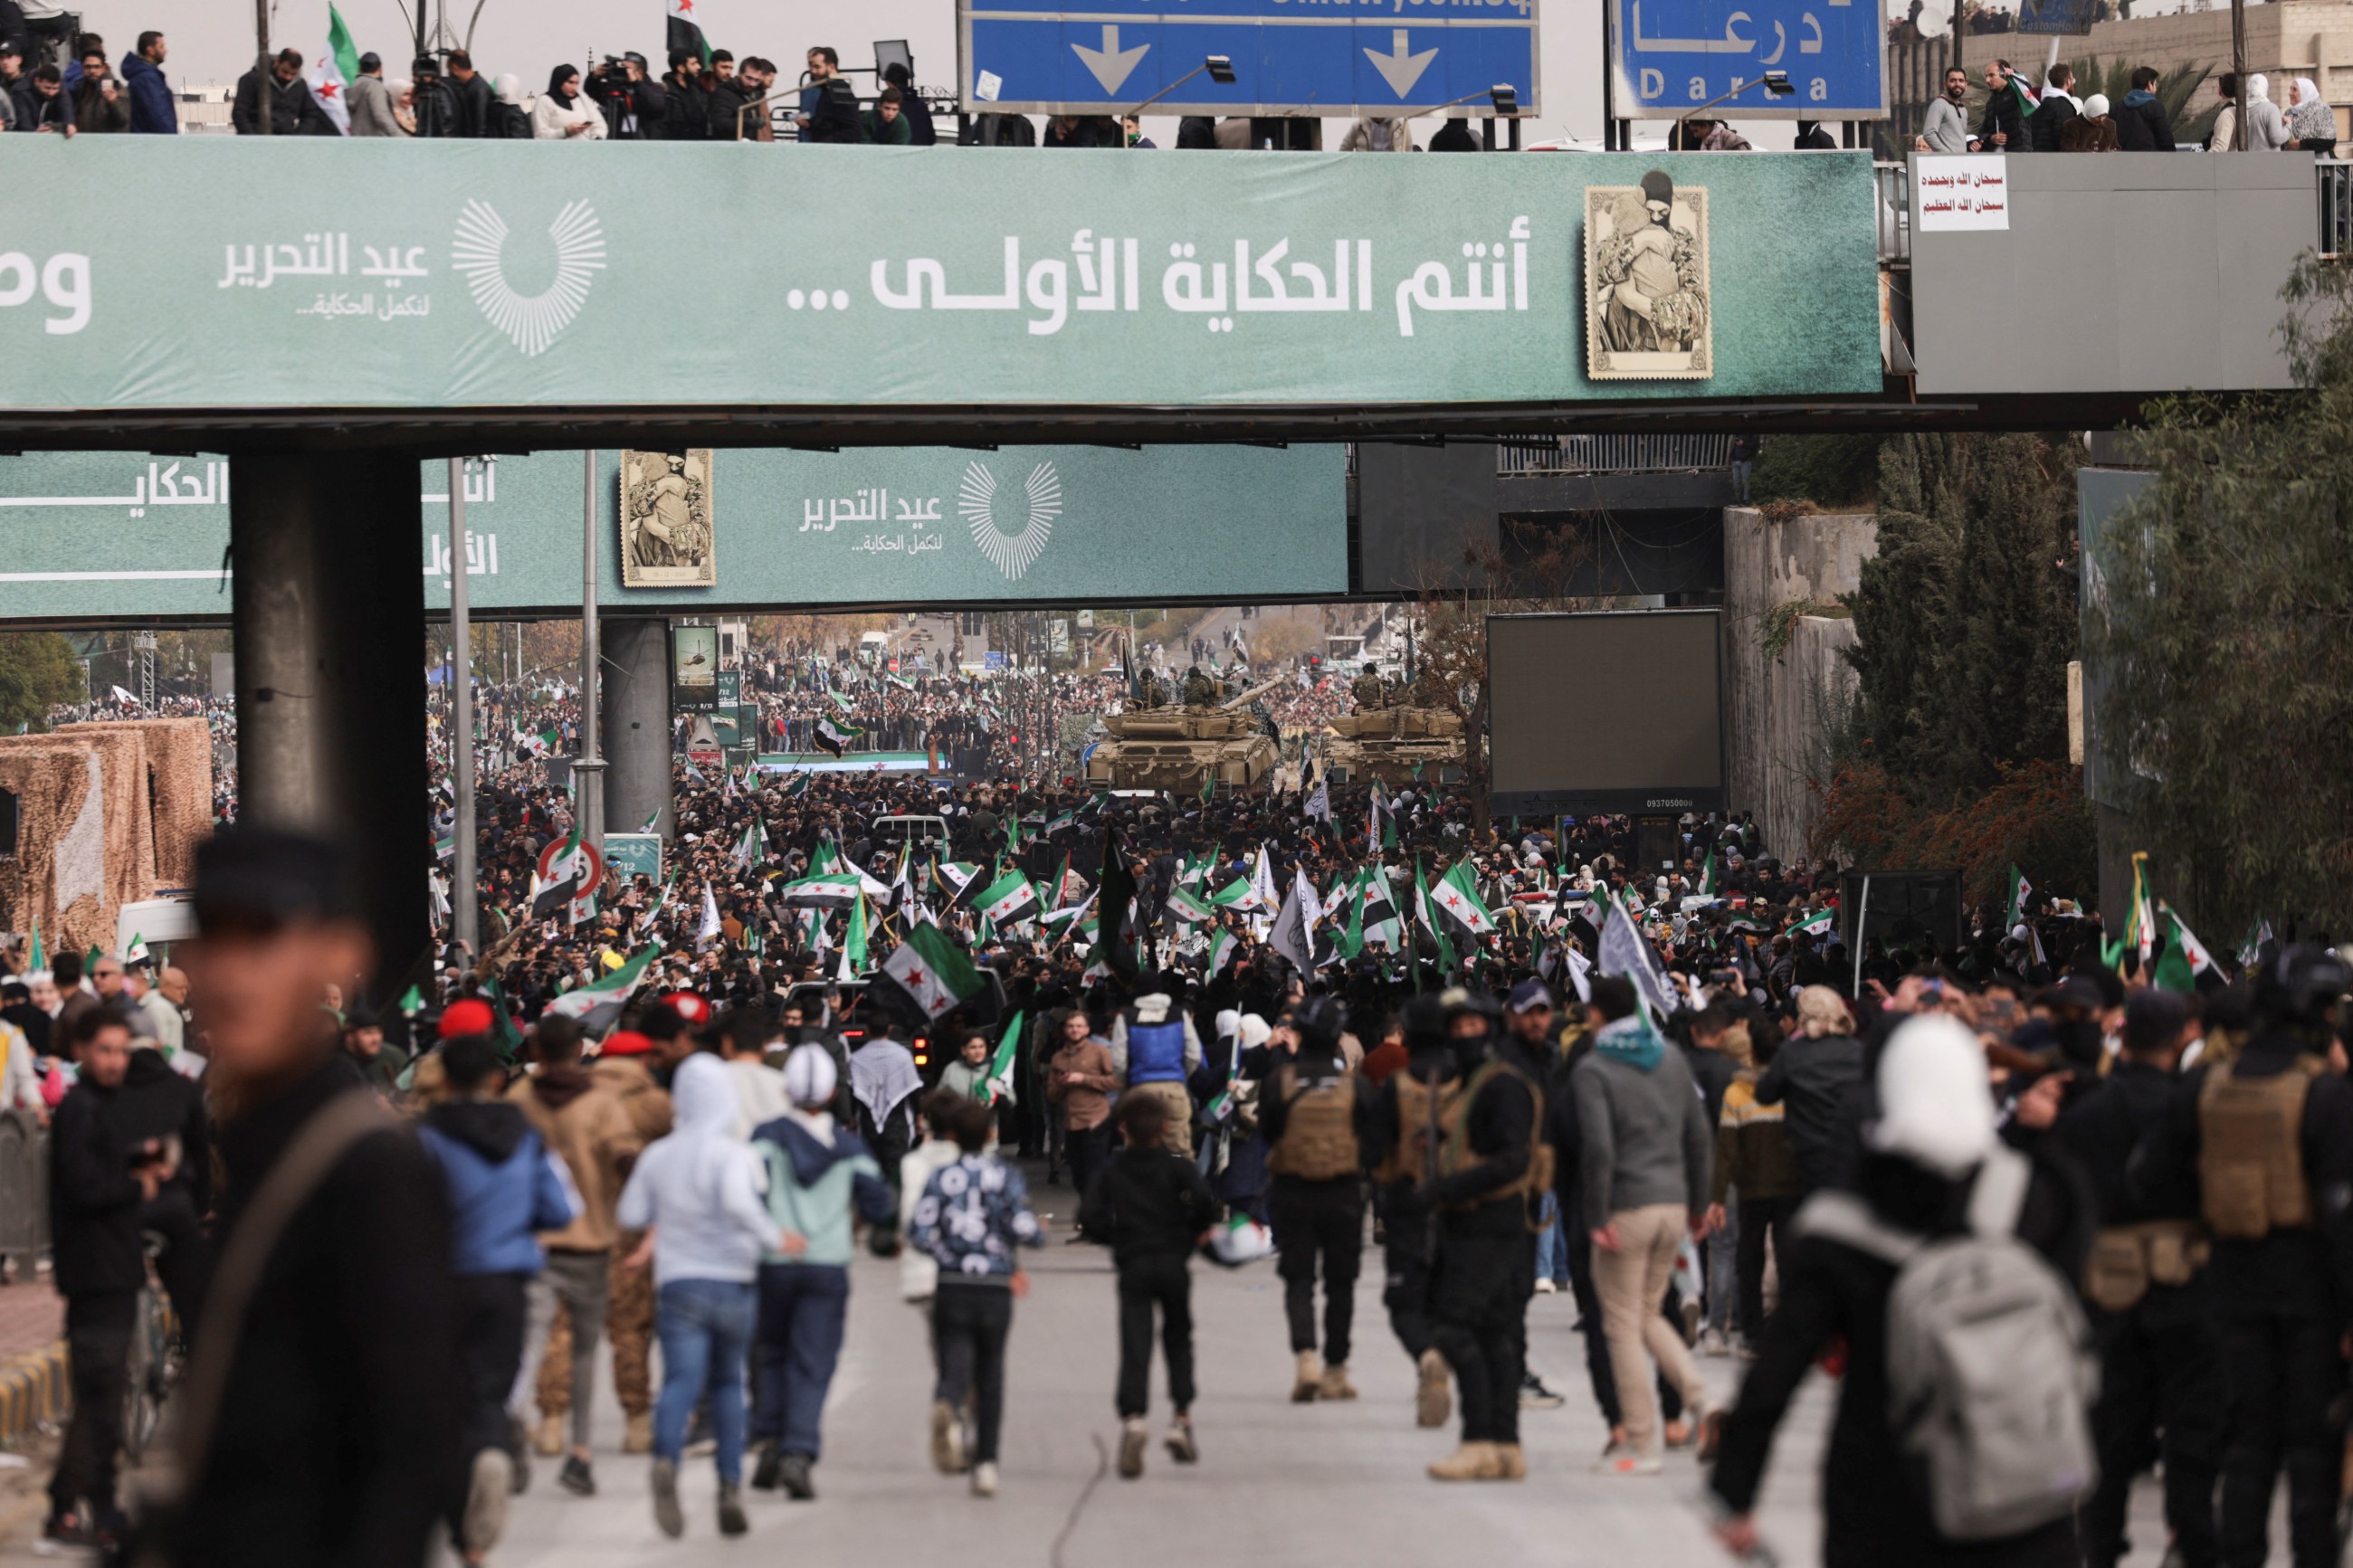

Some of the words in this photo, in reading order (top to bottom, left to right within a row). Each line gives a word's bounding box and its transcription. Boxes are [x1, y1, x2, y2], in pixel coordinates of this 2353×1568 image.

[1633, 0, 1823, 65] درعا
[1921, 174, 1955, 188] وبحمده
[1957, 171, 1970, 185] الله
[1974, 172, 2003, 187] سبحان
[1923, 198, 1955, 215] العظيم
[1958, 197, 1971, 211] الله
[1975, 198, 2004, 214] سبحان
[217, 232, 348, 289] التحرير
[361, 244, 429, 289] عيد
[871, 228, 1139, 336] الأولى
[1162, 236, 1373, 333] الحكاية
[1396, 215, 1530, 337] أنتم
[377, 294, 430, 321] لنكمل
[799, 489, 887, 532] التحرير
[896, 497, 941, 529] عيد
[908, 533, 942, 555] لنكمل
[1646, 799, 1693, 808] 0937050000
